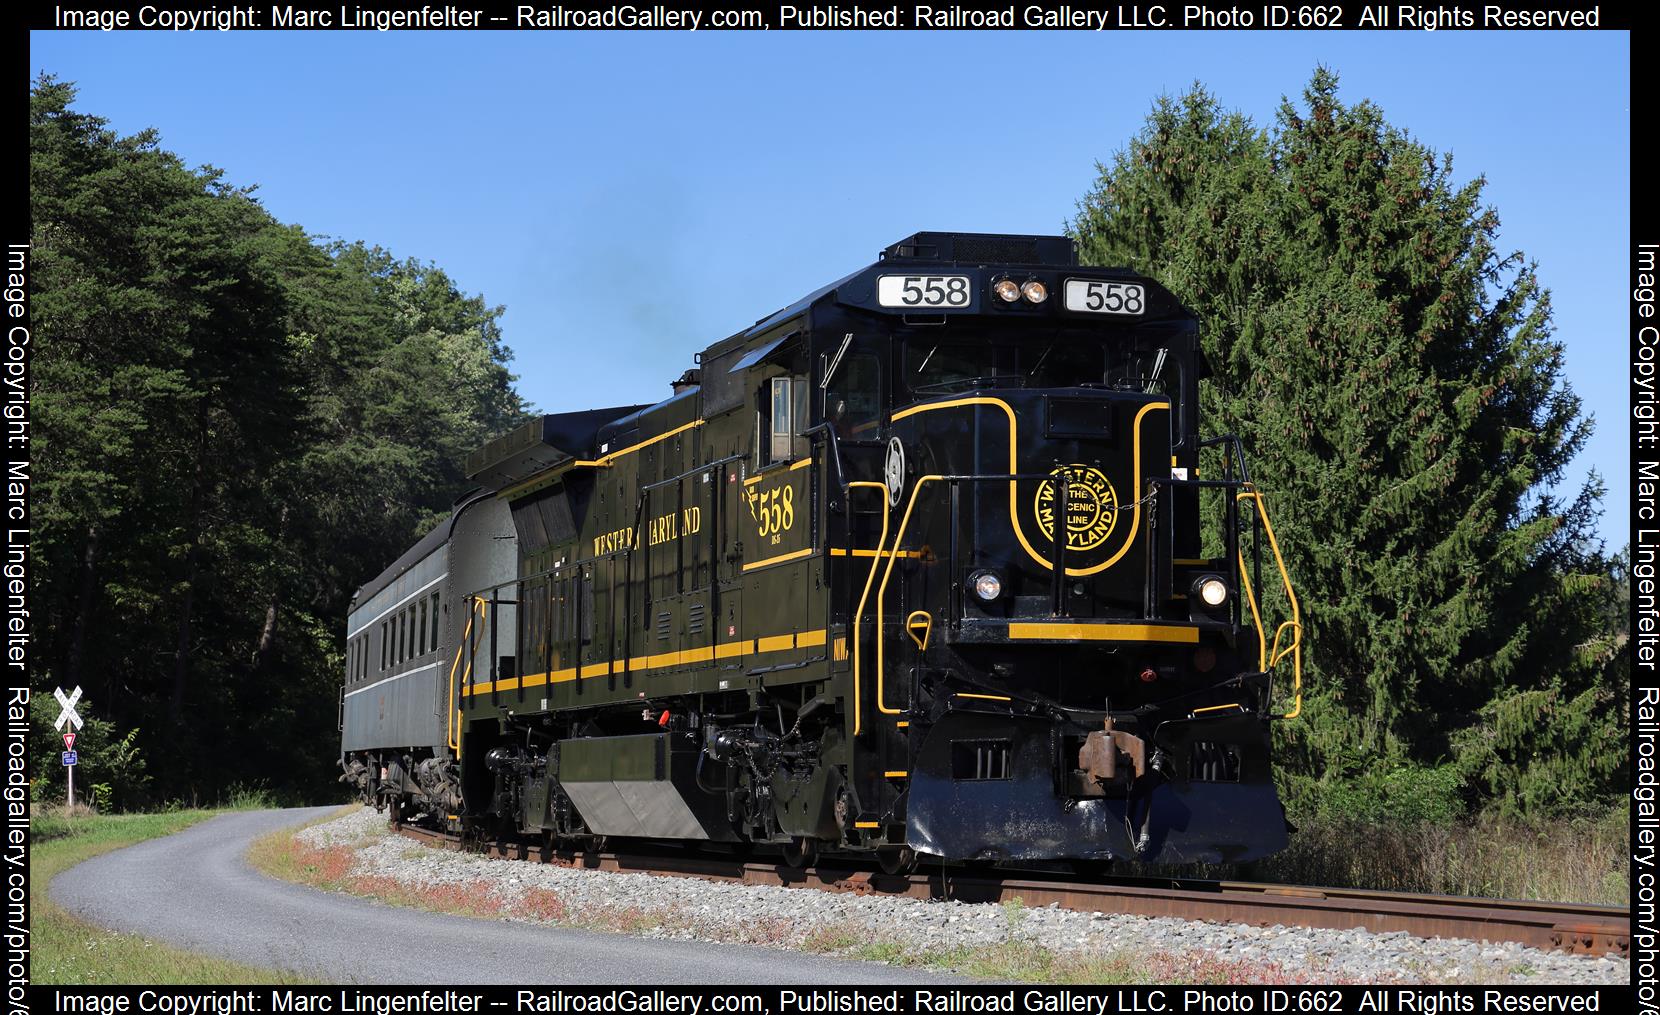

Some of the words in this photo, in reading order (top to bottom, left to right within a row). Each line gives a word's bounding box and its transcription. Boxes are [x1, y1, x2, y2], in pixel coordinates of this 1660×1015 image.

[901, 277, 968, 306] 558
[1085, 283, 1143, 314] 558
[1040, 469, 1113, 503] WSTERN
[1068, 490, 1088, 499] THE
[758, 484, 794, 537] 558
[1066, 502, 1095, 512] CENIC
[1066, 515, 1088, 525] LINE
[648, 506, 701, 546] ARYLND
[1040, 507, 1113, 545] MAYLAND
